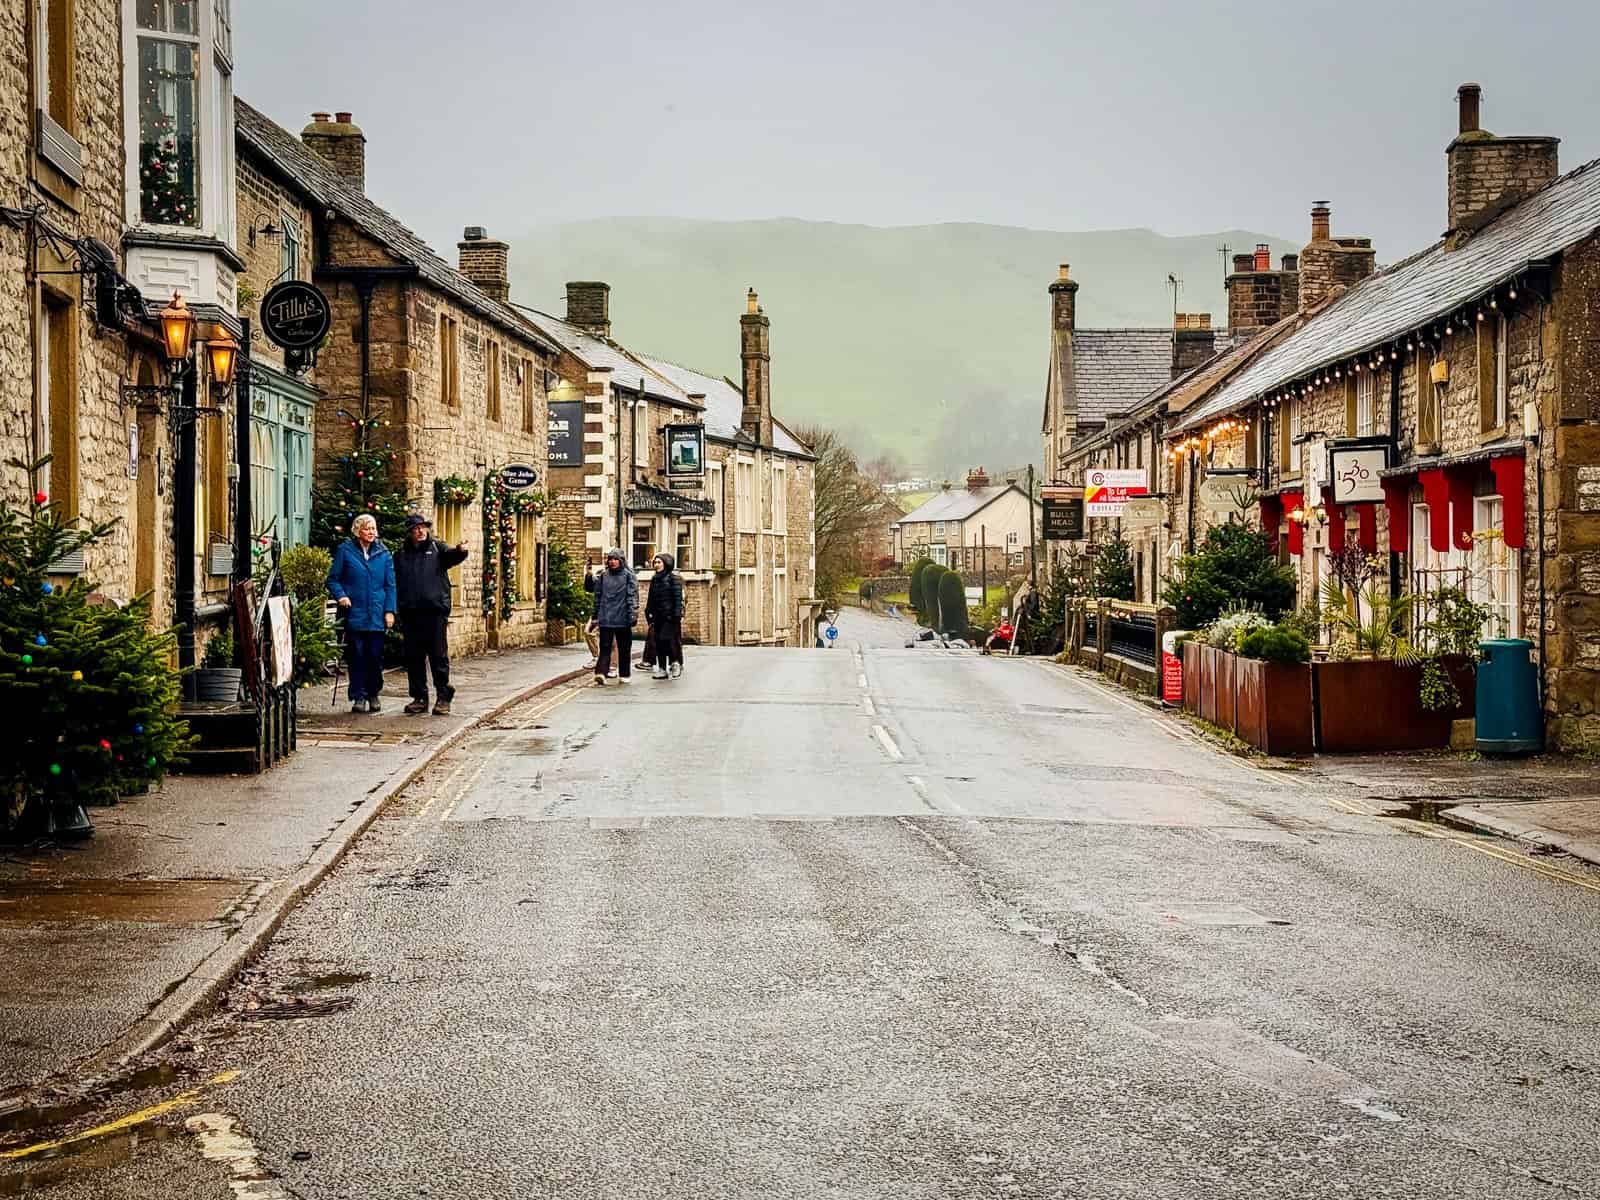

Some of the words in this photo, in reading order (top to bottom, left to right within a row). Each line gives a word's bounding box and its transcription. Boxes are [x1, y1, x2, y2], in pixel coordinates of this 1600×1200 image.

[270, 295, 315, 322] Tilly's
[548, 452, 568, 460] OMS
[1337, 459, 1369, 495] 1530
[1107, 487, 1114, 495] To
[1116, 487, 1127, 495] Let
